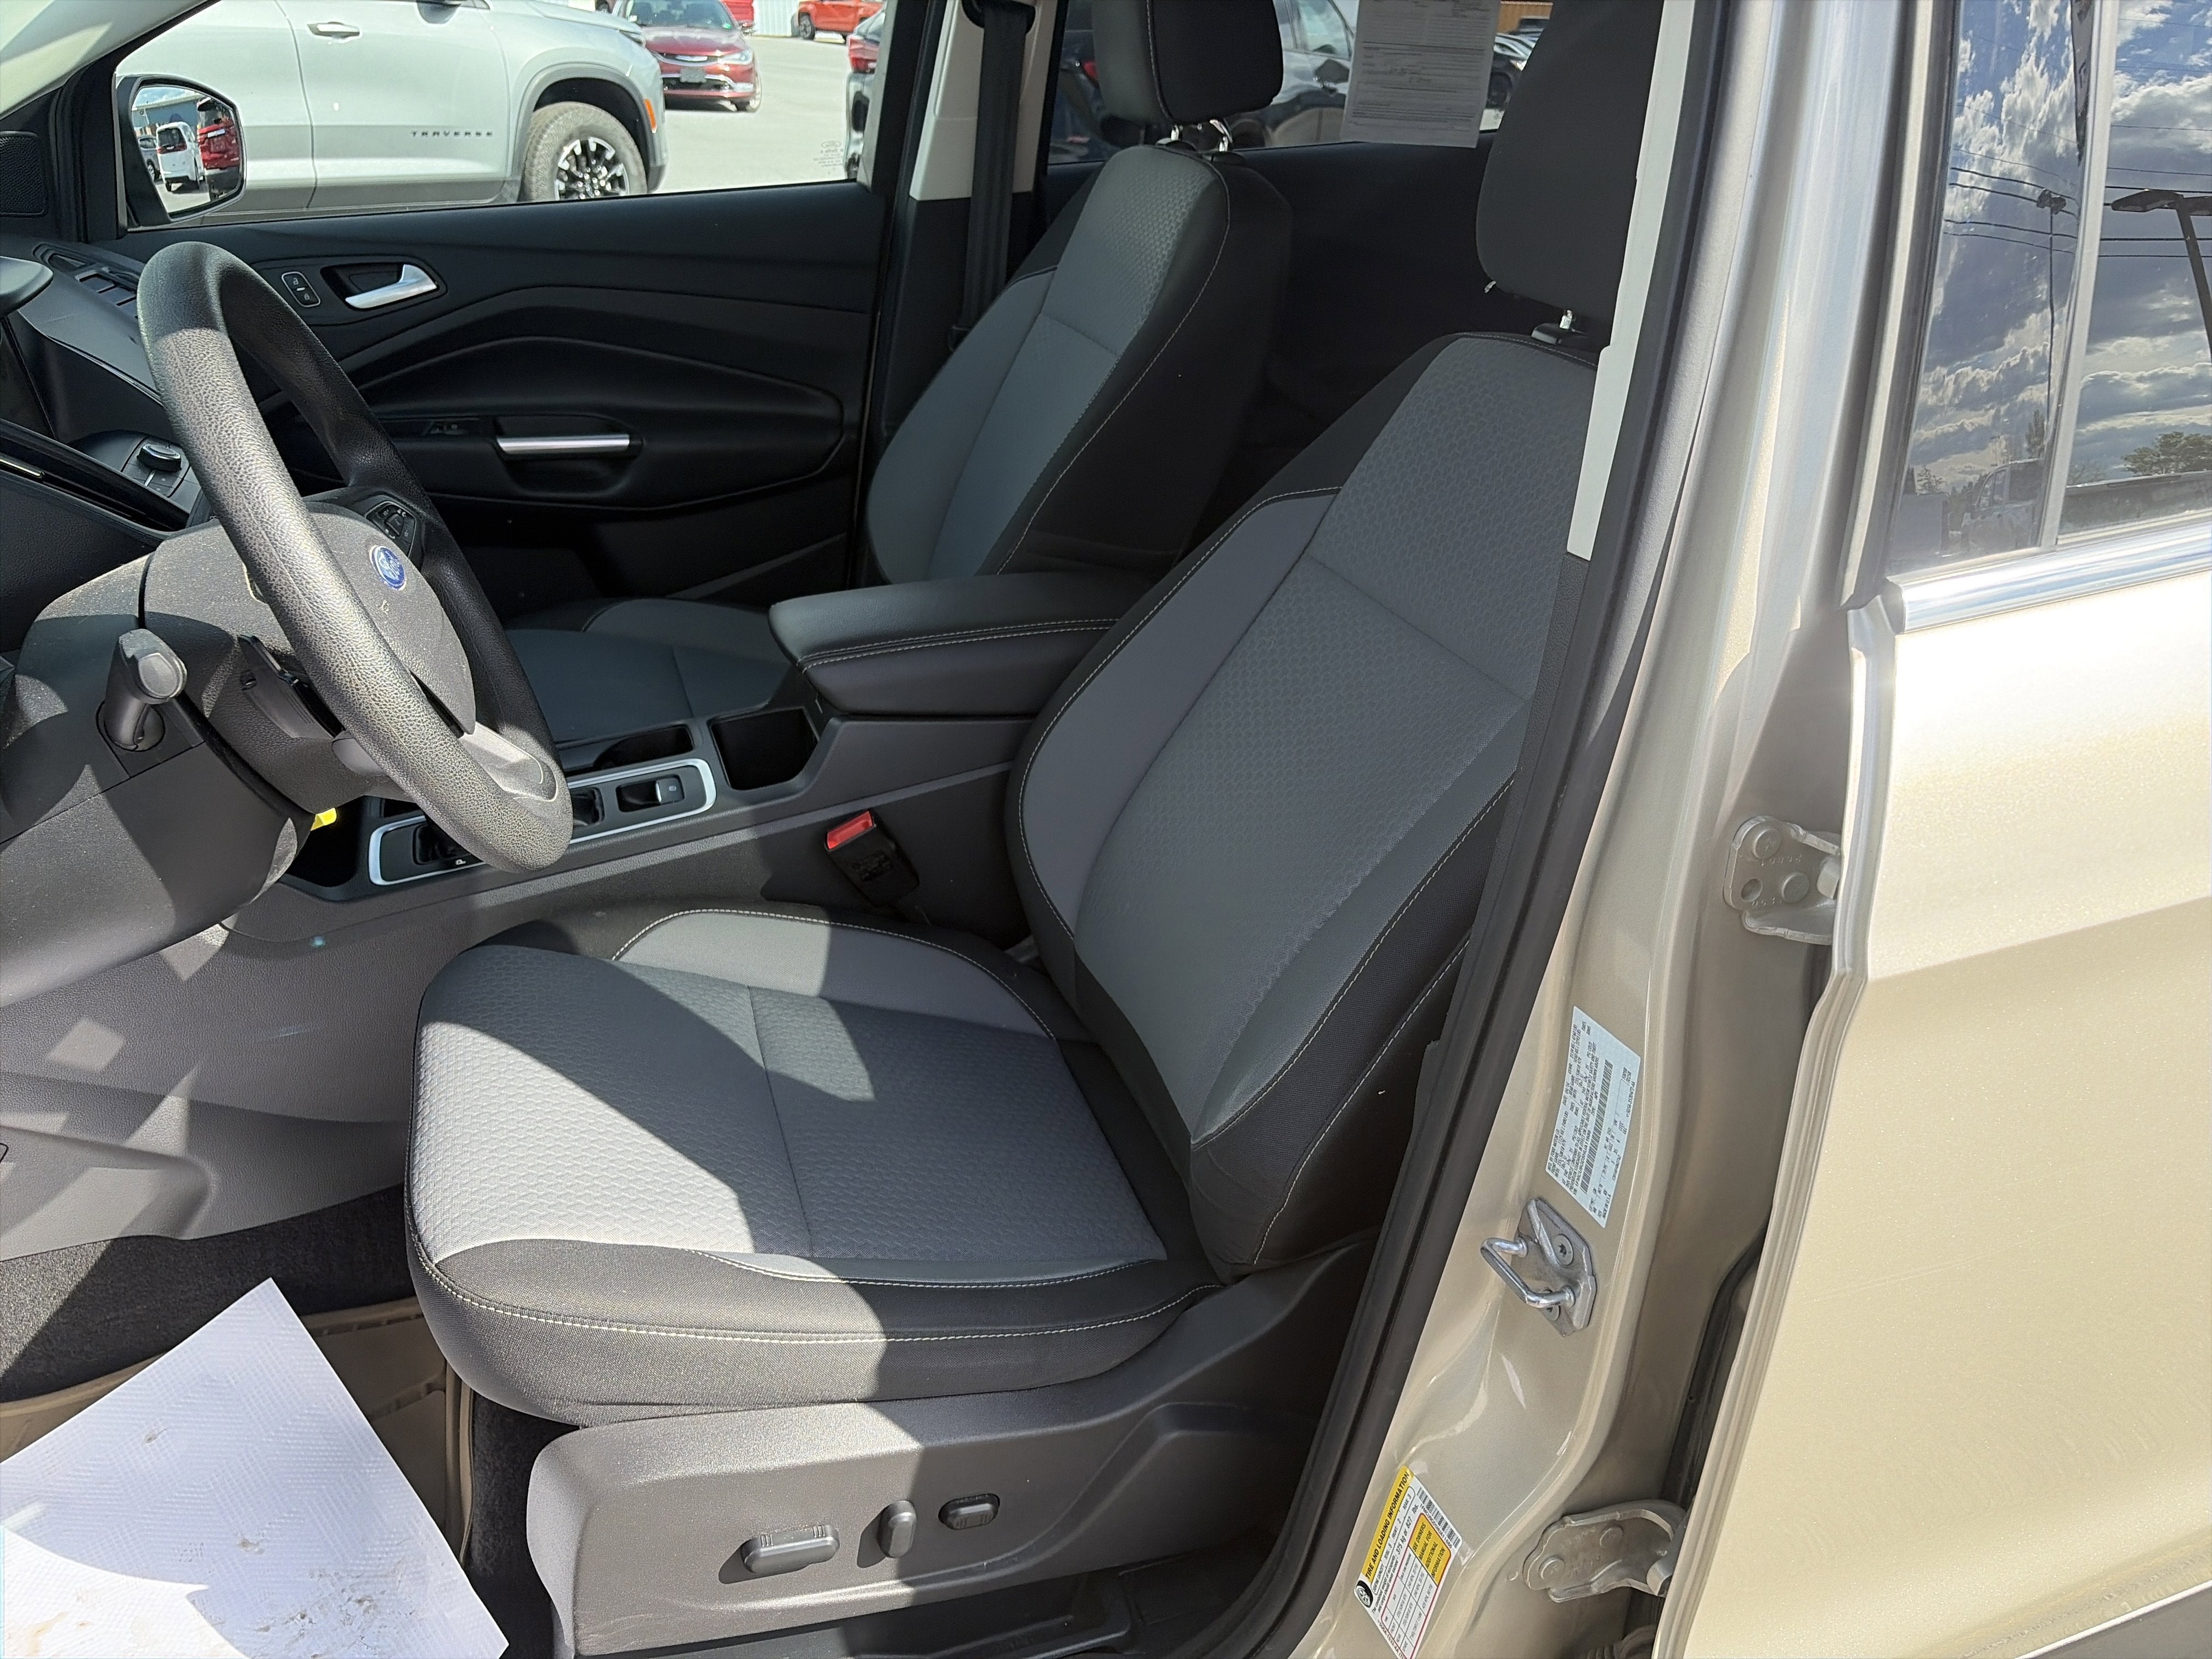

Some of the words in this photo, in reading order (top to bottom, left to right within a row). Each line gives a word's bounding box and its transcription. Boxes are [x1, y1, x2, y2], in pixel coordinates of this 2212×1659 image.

[1587, 1081, 1596, 1108] MANUFACTURE
[1577, 1115, 1585, 1137] APPLICABLE
[1365, 1562, 1374, 1579] TIRE
[1376, 1519, 1390, 1549] LOADING
[1387, 1471, 1409, 1520] INFORMATION
[1419, 1541, 1429, 1561] MANUAL
[1425, 1541, 1438, 1569] ADDITIONAL
[1431, 1547, 1446, 1578] INFORMATION
[1375, 1589, 1383, 1607] combined
[1387, 1555, 1396, 1574] occupants
